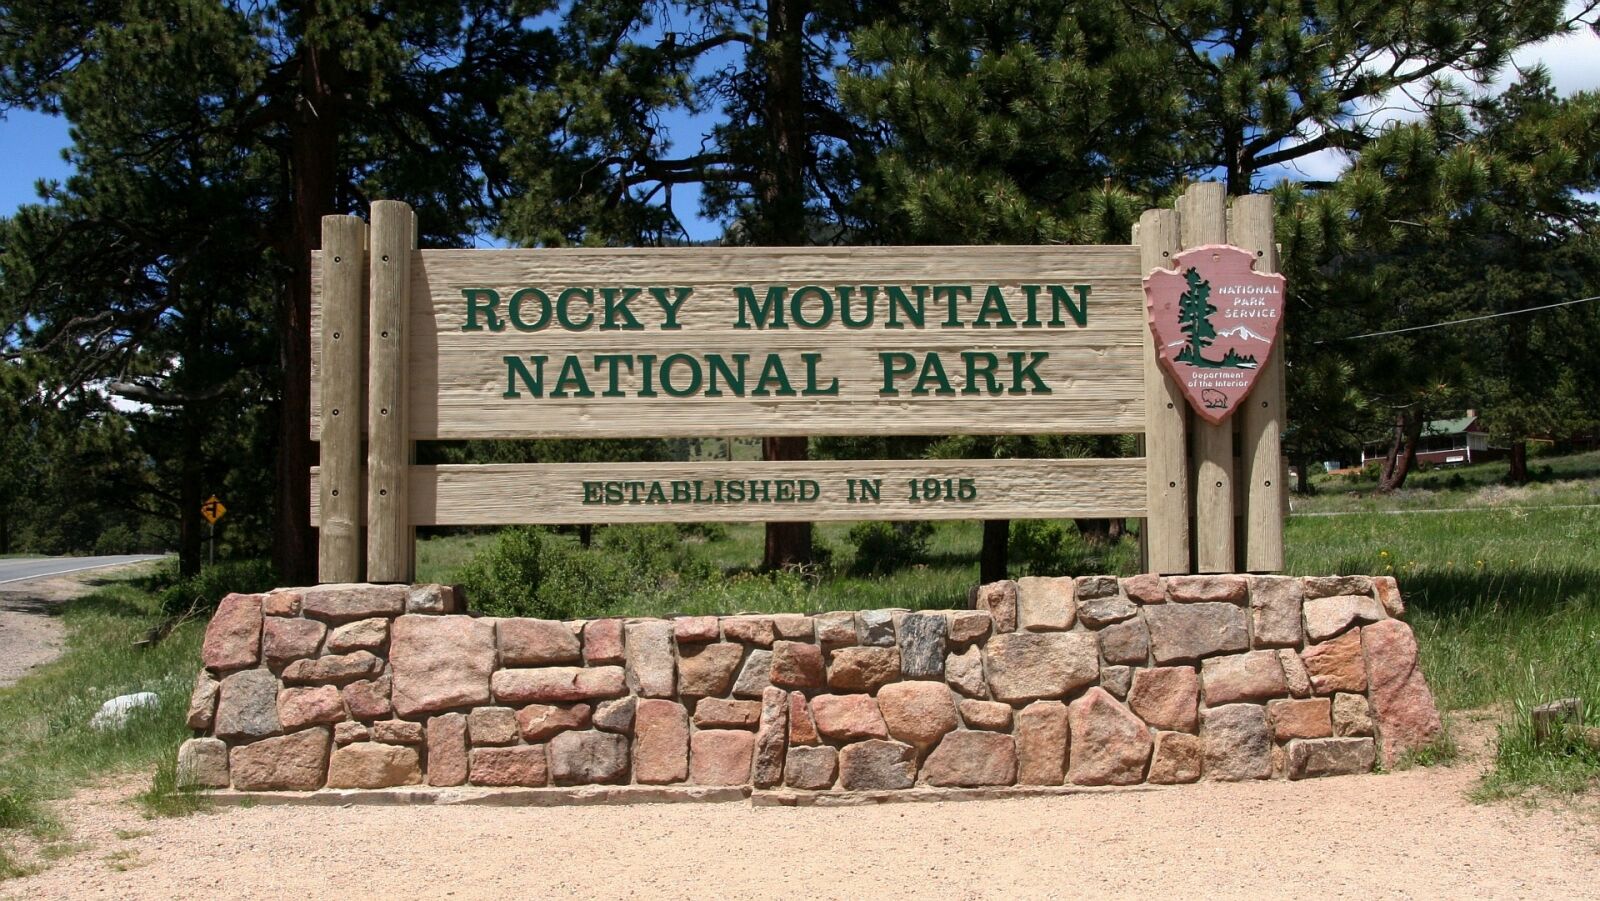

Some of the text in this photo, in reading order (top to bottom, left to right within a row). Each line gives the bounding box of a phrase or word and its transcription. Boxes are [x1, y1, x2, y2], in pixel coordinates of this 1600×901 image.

[1218, 285, 1280, 295] NATIONAL
[1233, 297, 1266, 307] PARK
[461, 284, 1092, 331] ROCKY MOUNTAIN
[1224, 308, 1277, 318] SERVICE
[503, 351, 1052, 399] NATIONAL PARK
[1192, 371, 1244, 380] Department
[582, 478, 977, 504] ESTABLISHED IN 1915
